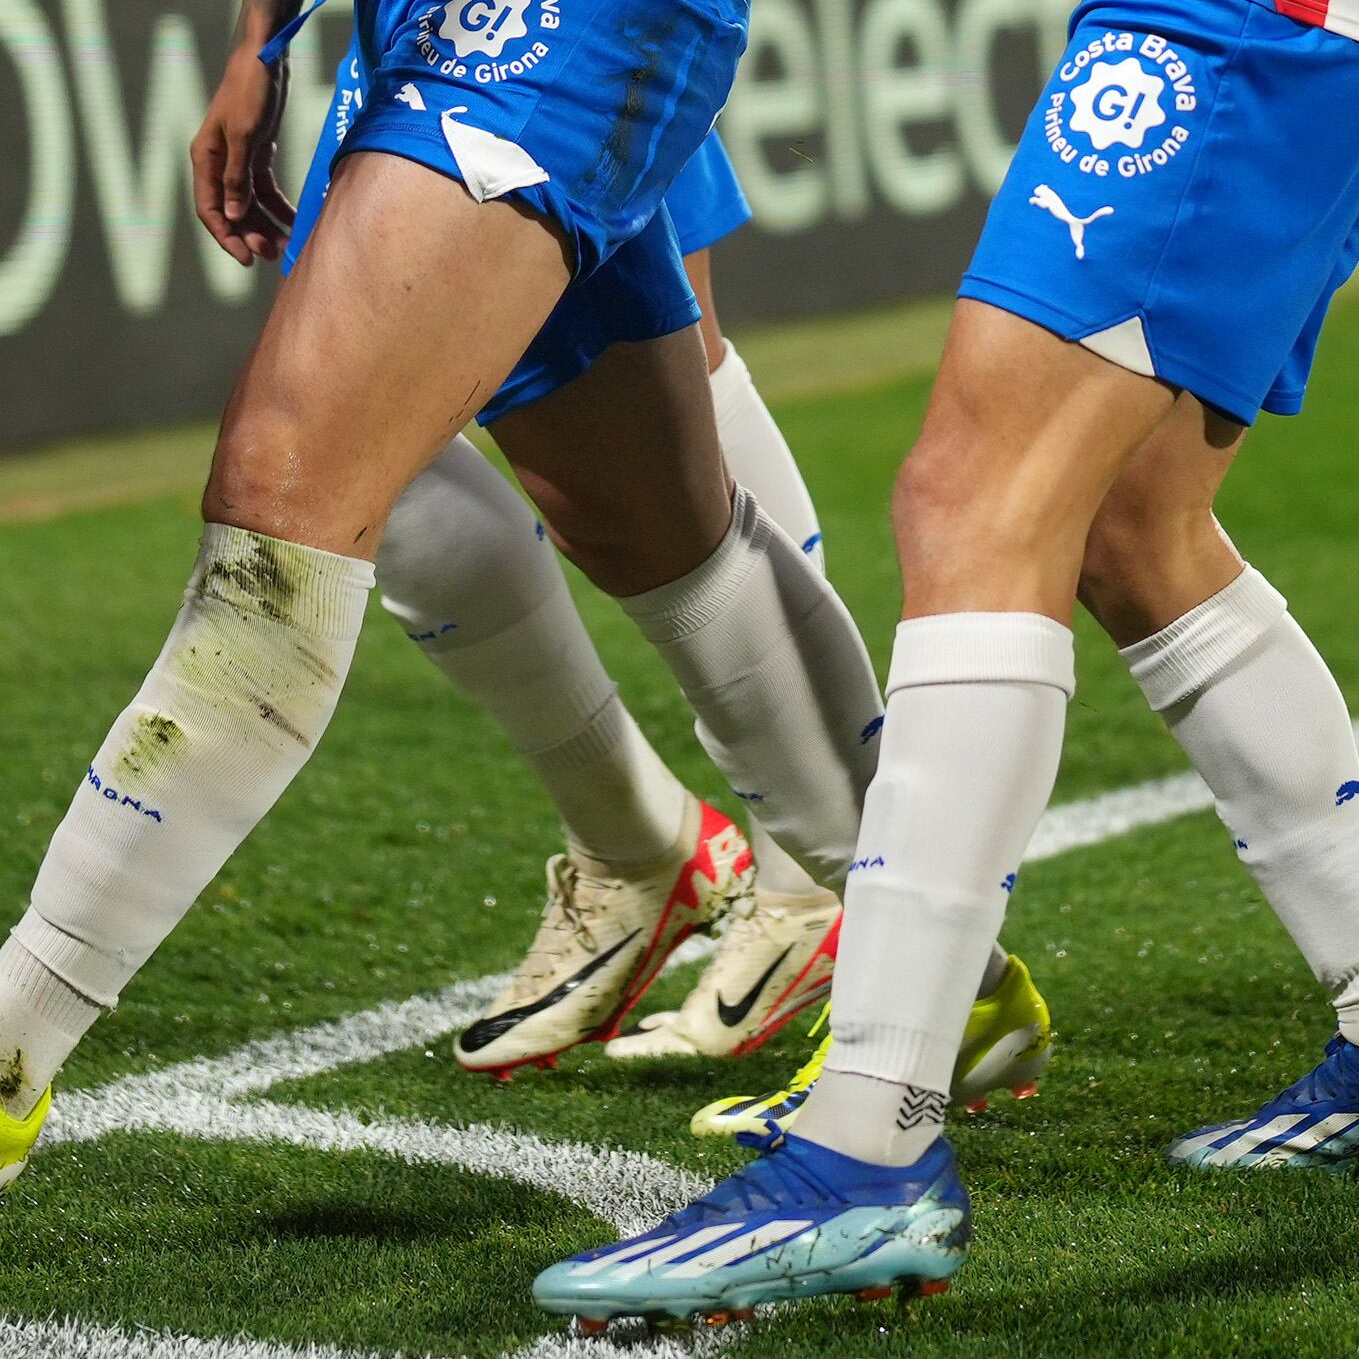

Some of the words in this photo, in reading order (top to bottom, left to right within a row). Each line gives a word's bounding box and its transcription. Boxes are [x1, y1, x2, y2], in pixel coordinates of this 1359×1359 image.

[440, 58, 467, 78] de
[474, 41, 550, 83] Girona
[1059, 31, 1134, 82] Costa
[1139, 33, 1197, 111] Brava
[336, 89, 353, 142] Pirin
[1045, 91, 1079, 164] Pirineu
[1079, 153, 1110, 177] de
[1117, 125, 1190, 178] Girona
